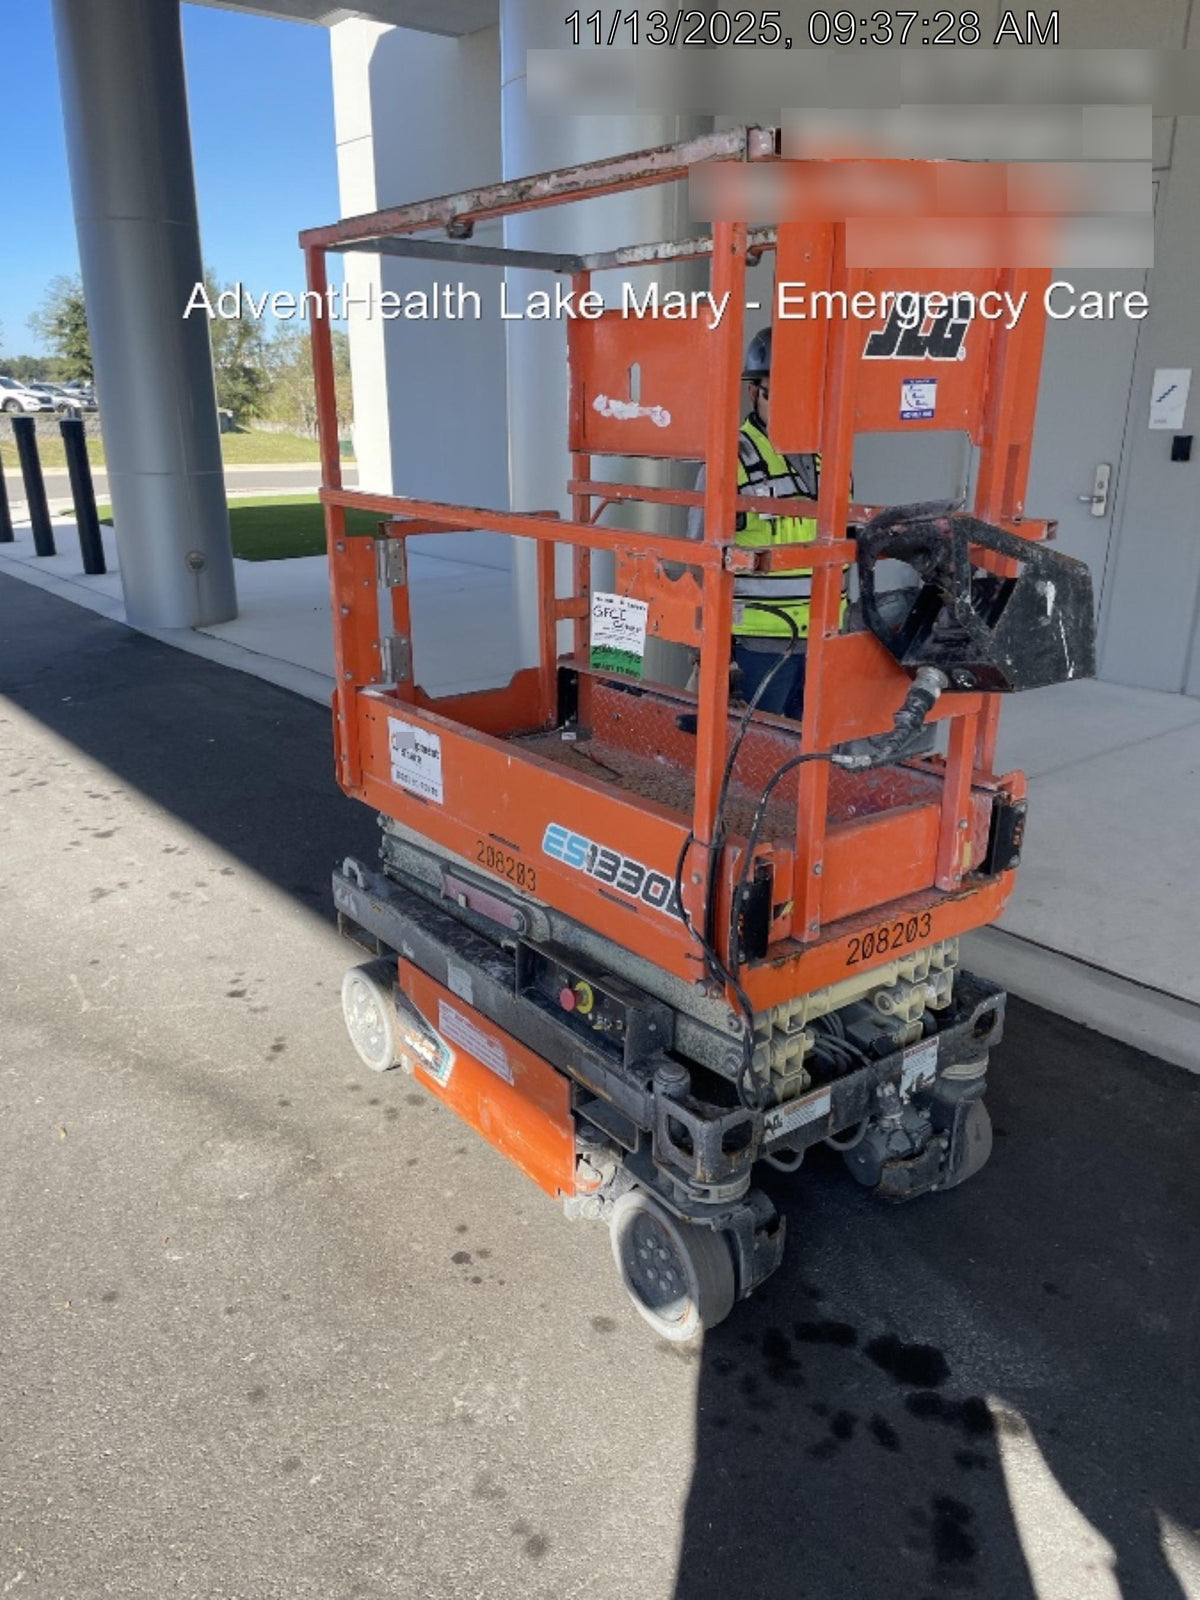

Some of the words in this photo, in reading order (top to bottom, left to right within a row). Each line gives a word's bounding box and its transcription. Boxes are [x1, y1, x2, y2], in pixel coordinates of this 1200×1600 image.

[862, 295, 972, 361] JLG
[476, 839, 537, 892] 208203
[846, 912, 932, 966] 208203
